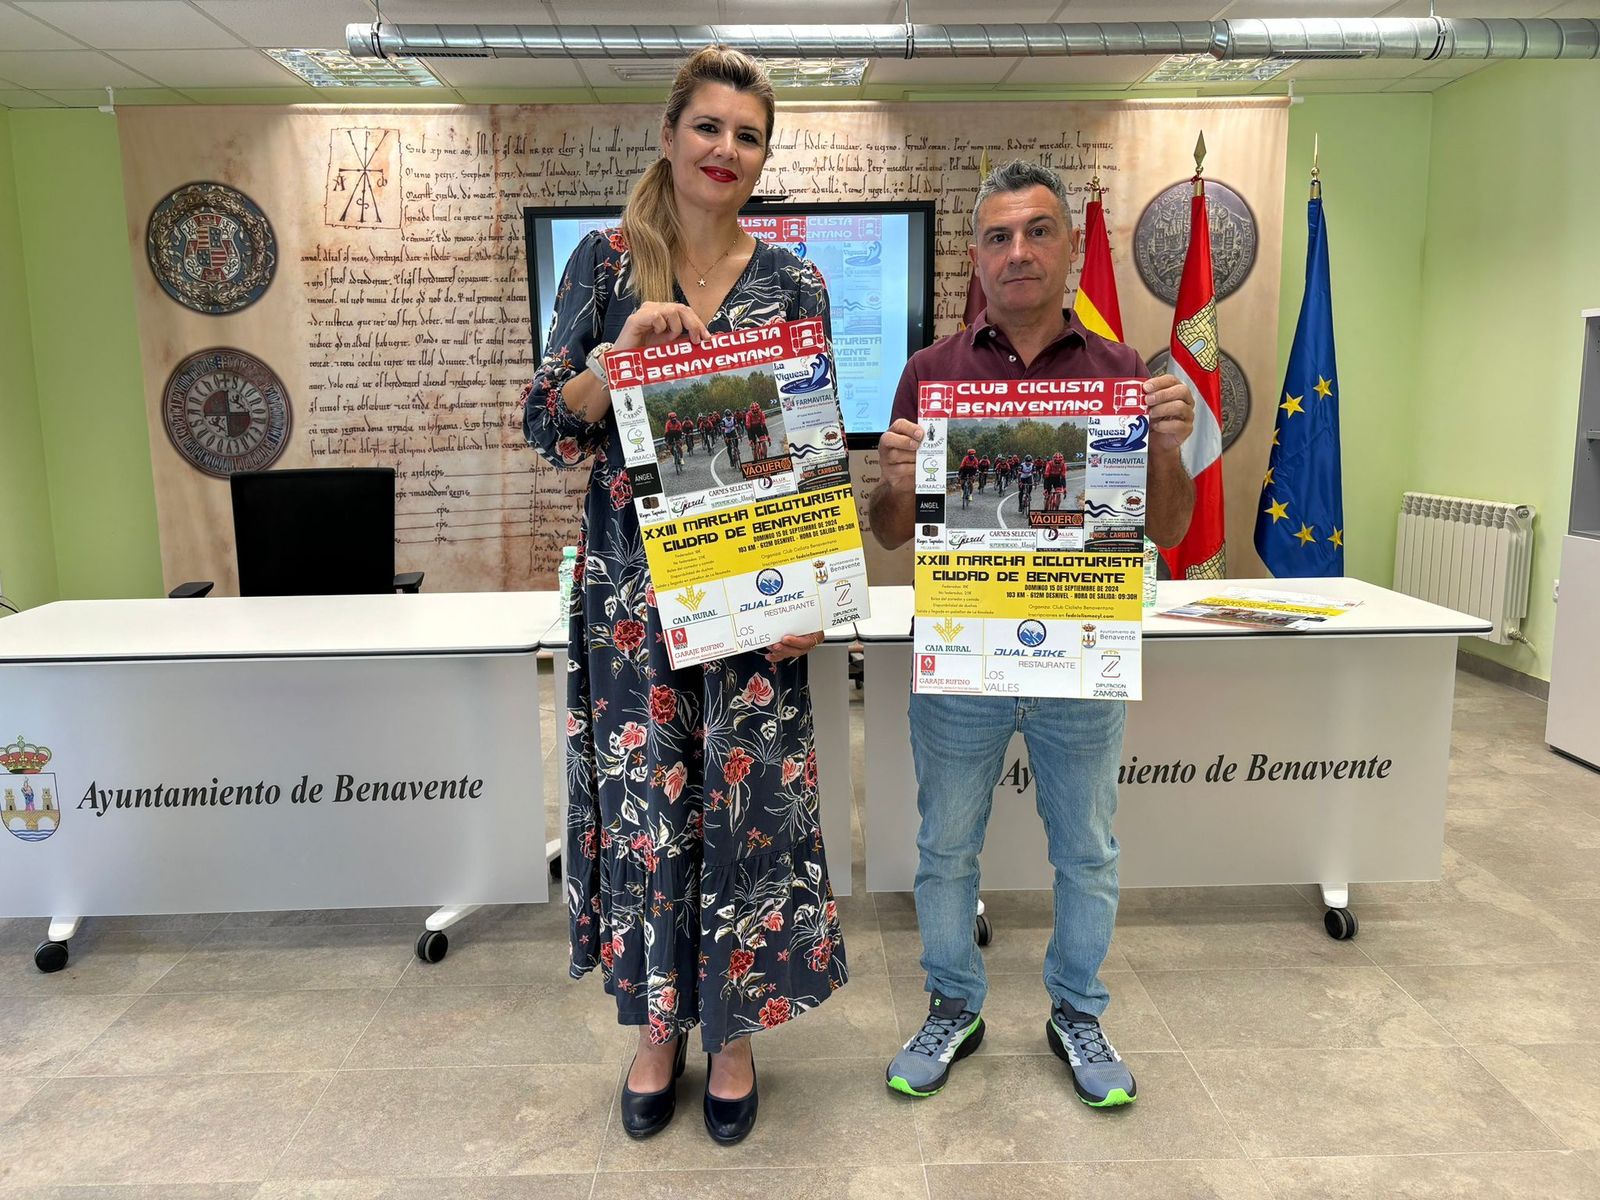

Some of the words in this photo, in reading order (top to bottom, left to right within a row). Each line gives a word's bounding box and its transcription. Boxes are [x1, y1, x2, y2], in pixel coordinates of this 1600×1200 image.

[738, 218, 777, 228] LISTA
[643, 342, 693, 361] CLUB
[701, 326, 781, 351] CICLISTA
[646, 345, 784, 379] BENAVENTANO
[774, 362, 784, 371] La
[957, 383, 1008, 395] CLUB
[1017, 380, 1105, 394] CICLISTA
[796, 394, 833, 407] FARMAVITAL
[957, 399, 1103, 413] BENAVENTANO
[1088, 417, 1101, 425] La
[1088, 428, 1126, 438] Viguesa
[1103, 457, 1145, 465] FARMAVITAL
[644, 523, 678, 541] XXIII
[683, 509, 749, 532] MARCHA
[755, 487, 854, 517] CICLOTURISTA
[663, 532, 718, 553] CIUDAD
[725, 526, 746, 540] DE
[752, 506, 841, 534] BENAVENTE
[830, 561, 861, 574] Benavente
[917, 555, 949, 566] XXIII
[957, 556, 1025, 566] MARCHA
[1033, 556, 1143, 568] CICLOTURISTA
[933, 570, 989, 581] CIUDAD
[997, 571, 1019, 582] DE
[1027, 572, 1126, 584] BENAVENTE
[775, 591, 805, 604] BIKE
[692, 609, 718, 621] RURAL
[764, 600, 815, 618] RESTAURANTE
[832, 614, 861, 627] ZAMORA
[737, 625, 755, 638] LOS
[1100, 634, 1136, 642] Benavente
[737, 633, 771, 650] VALLES
[946, 645, 972, 653] RURAL
[1032, 649, 1067, 658] BIKE
[1018, 660, 1076, 670] RESTAURANTE
[985, 671, 1005, 680] LOS
[984, 682, 1020, 693] VALLES
[1093, 689, 1128, 698] ZAMORA
[1205, 754, 1239, 784] de
[1245, 753, 1393, 783] Benavente
[77, 777, 281, 818] Ayuntamiento
[292, 775, 324, 805] de
[333, 773, 485, 804] Benavente
